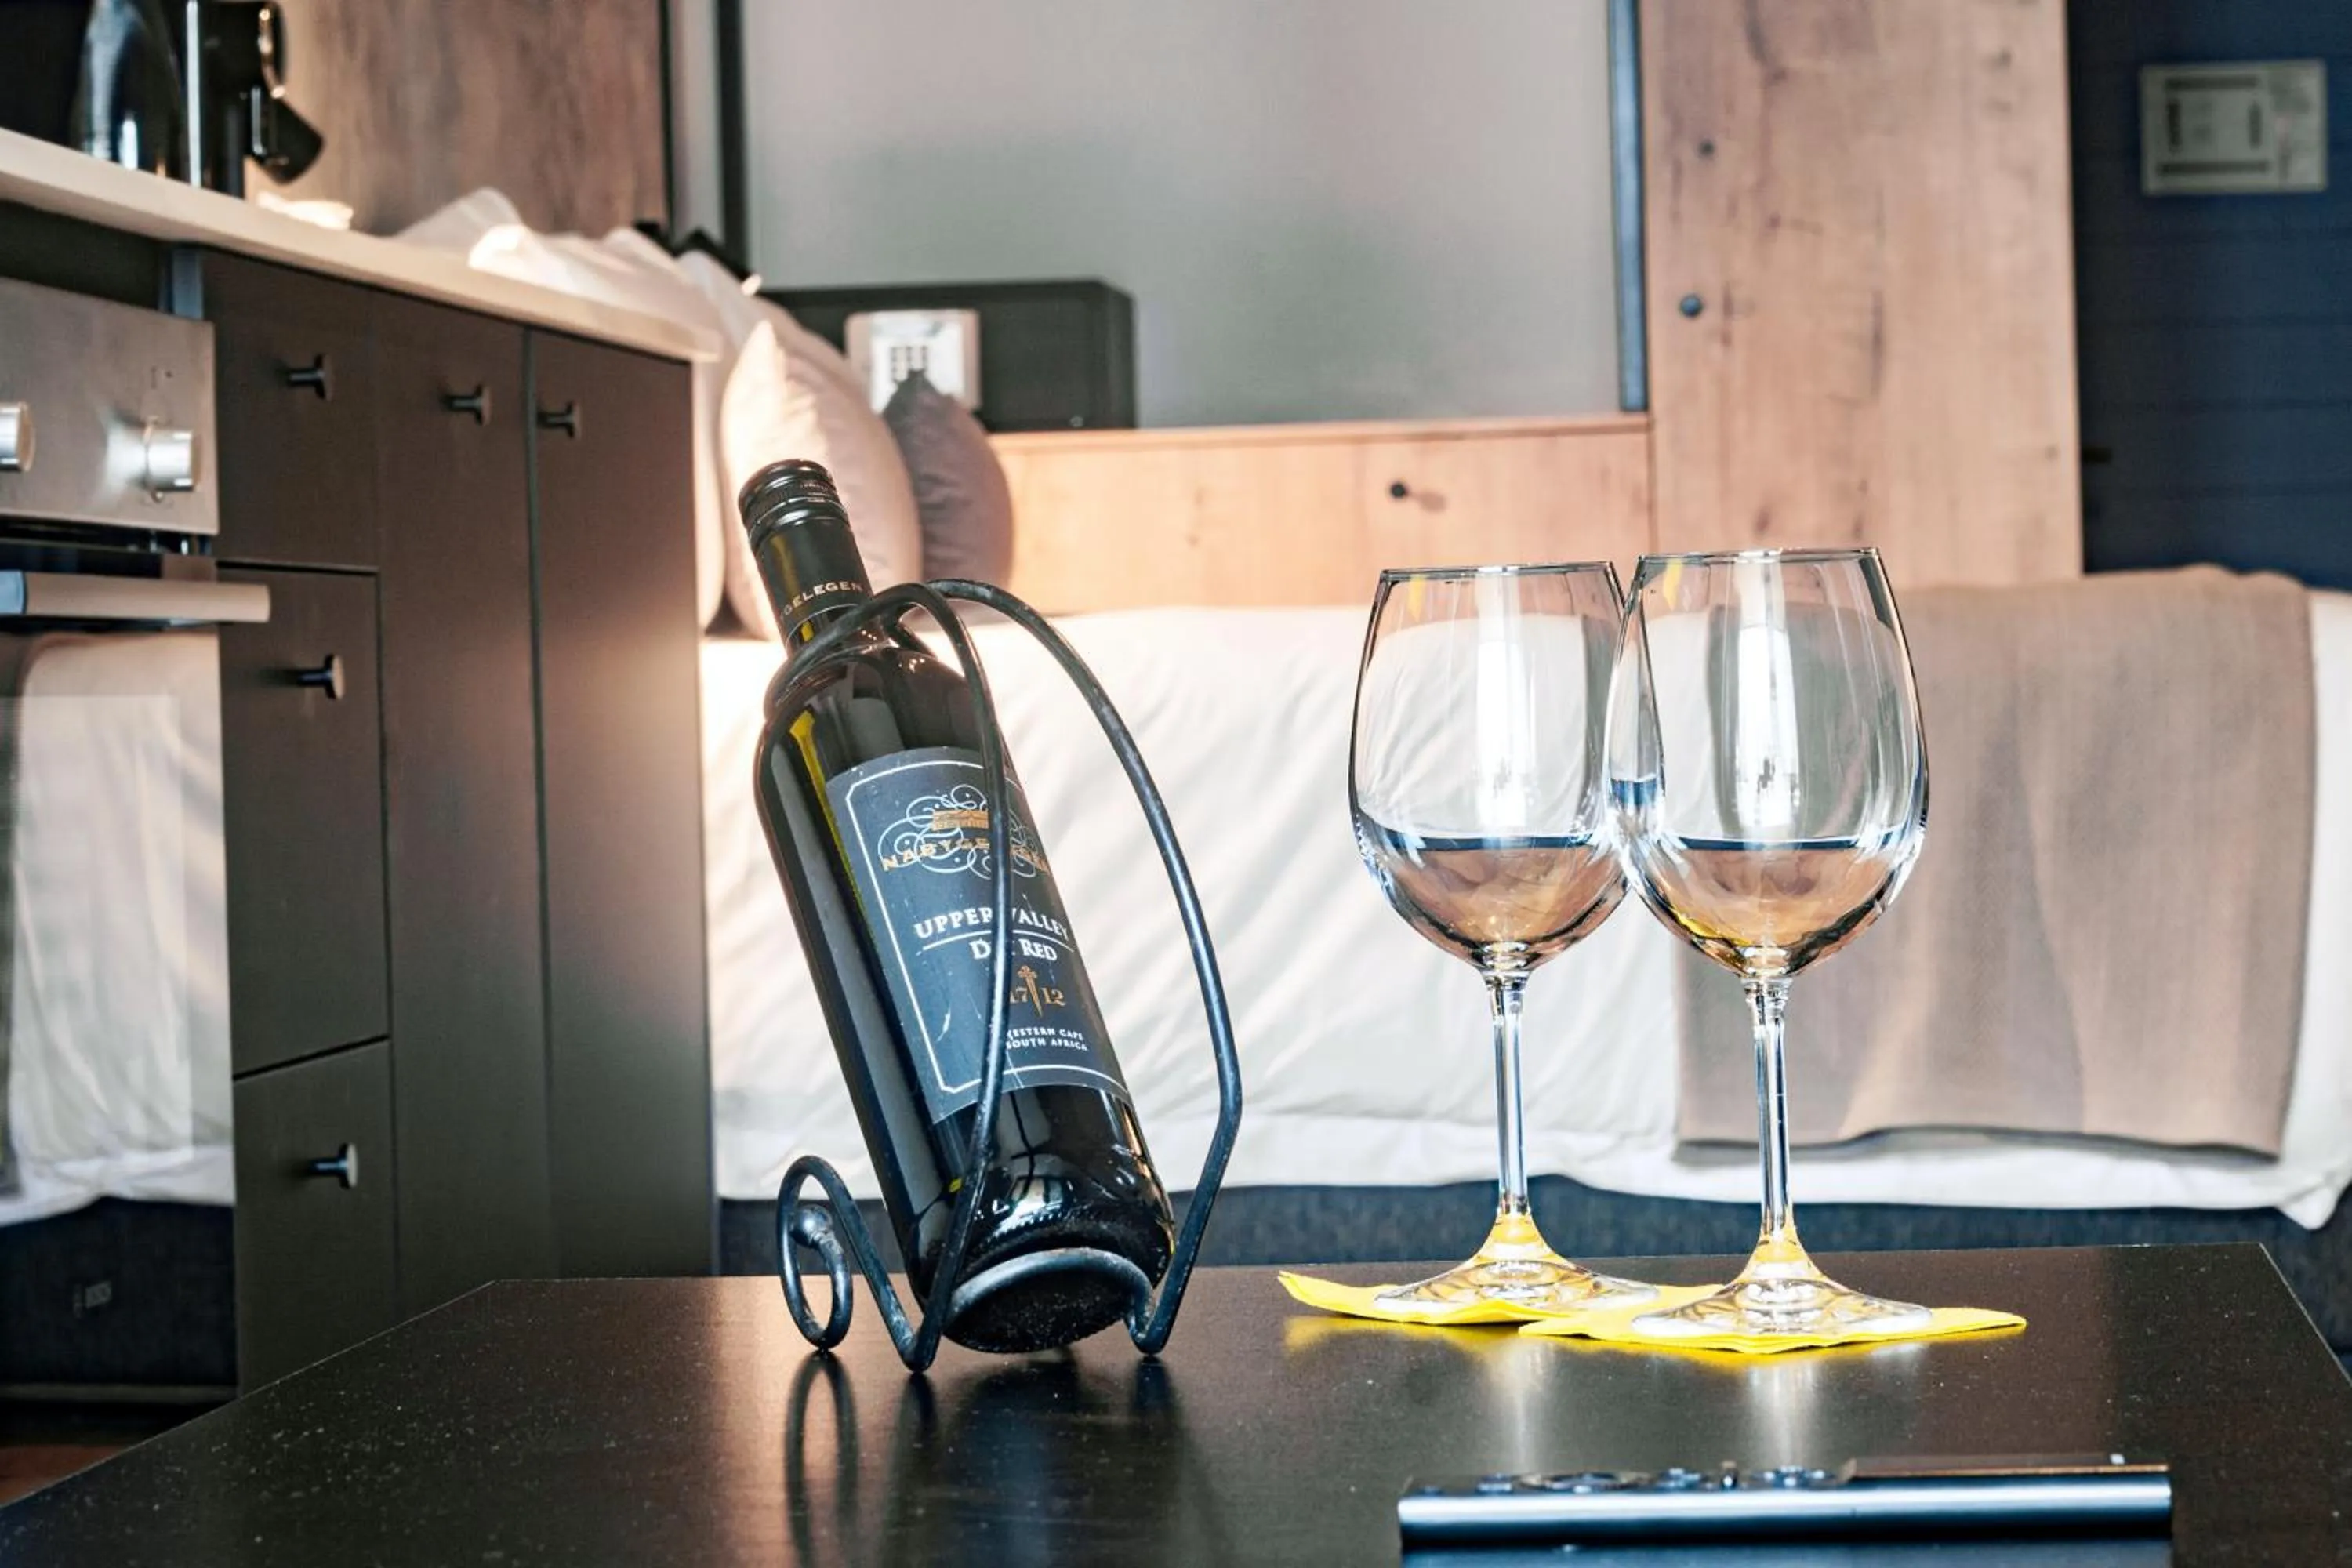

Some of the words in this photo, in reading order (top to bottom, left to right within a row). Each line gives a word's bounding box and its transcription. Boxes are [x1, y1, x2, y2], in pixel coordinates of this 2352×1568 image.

[914, 907, 993, 938] UPPER
[1012, 907, 1069, 942] ALLEY
[1018, 938, 1058, 961] RED
[1005, 1037, 1047, 1050] SOUTH
[1051, 1038, 1088, 1051] AFRICA
